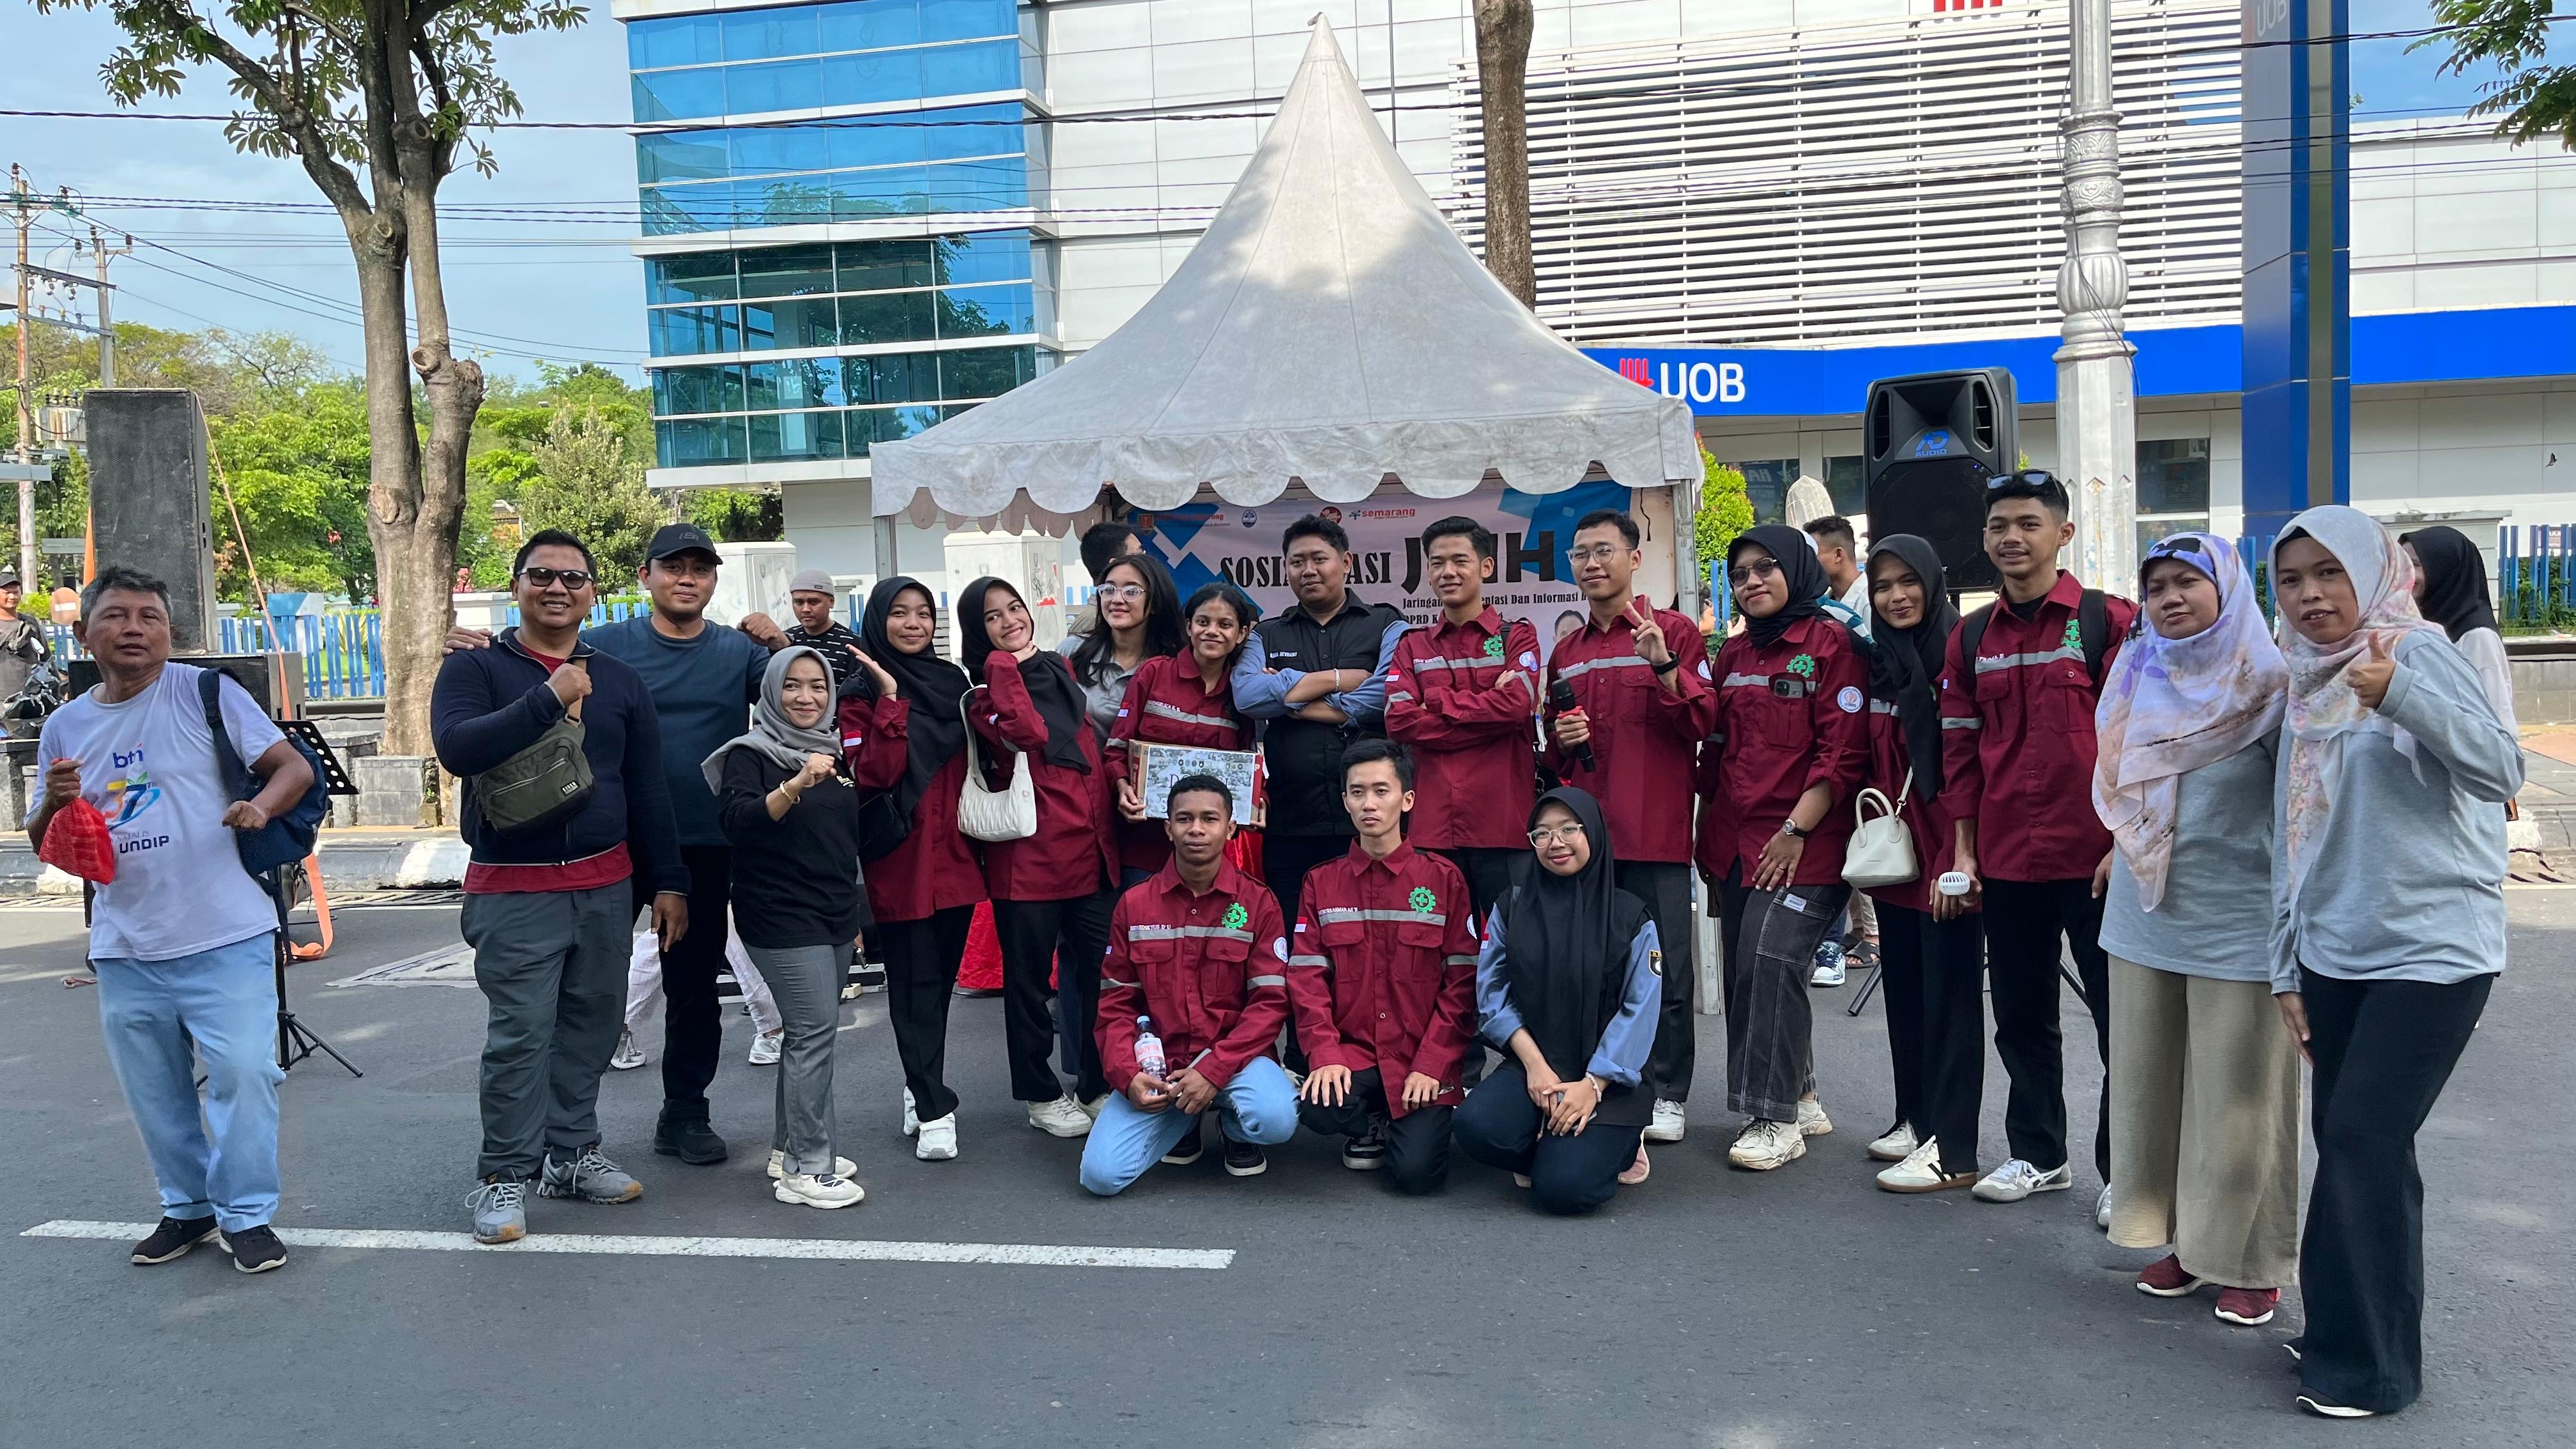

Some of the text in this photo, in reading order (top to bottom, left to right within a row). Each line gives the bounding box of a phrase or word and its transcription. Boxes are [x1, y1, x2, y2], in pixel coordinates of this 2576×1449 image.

[1660, 362, 1745, 403] UOB
[1915, 448, 1947, 457] AUDIO
[1361, 509, 1416, 517] semarang
[1482, 594, 1508, 605] entasi
[1511, 594, 1530, 604] Dan
[1533, 592, 1578, 604] Informasi
